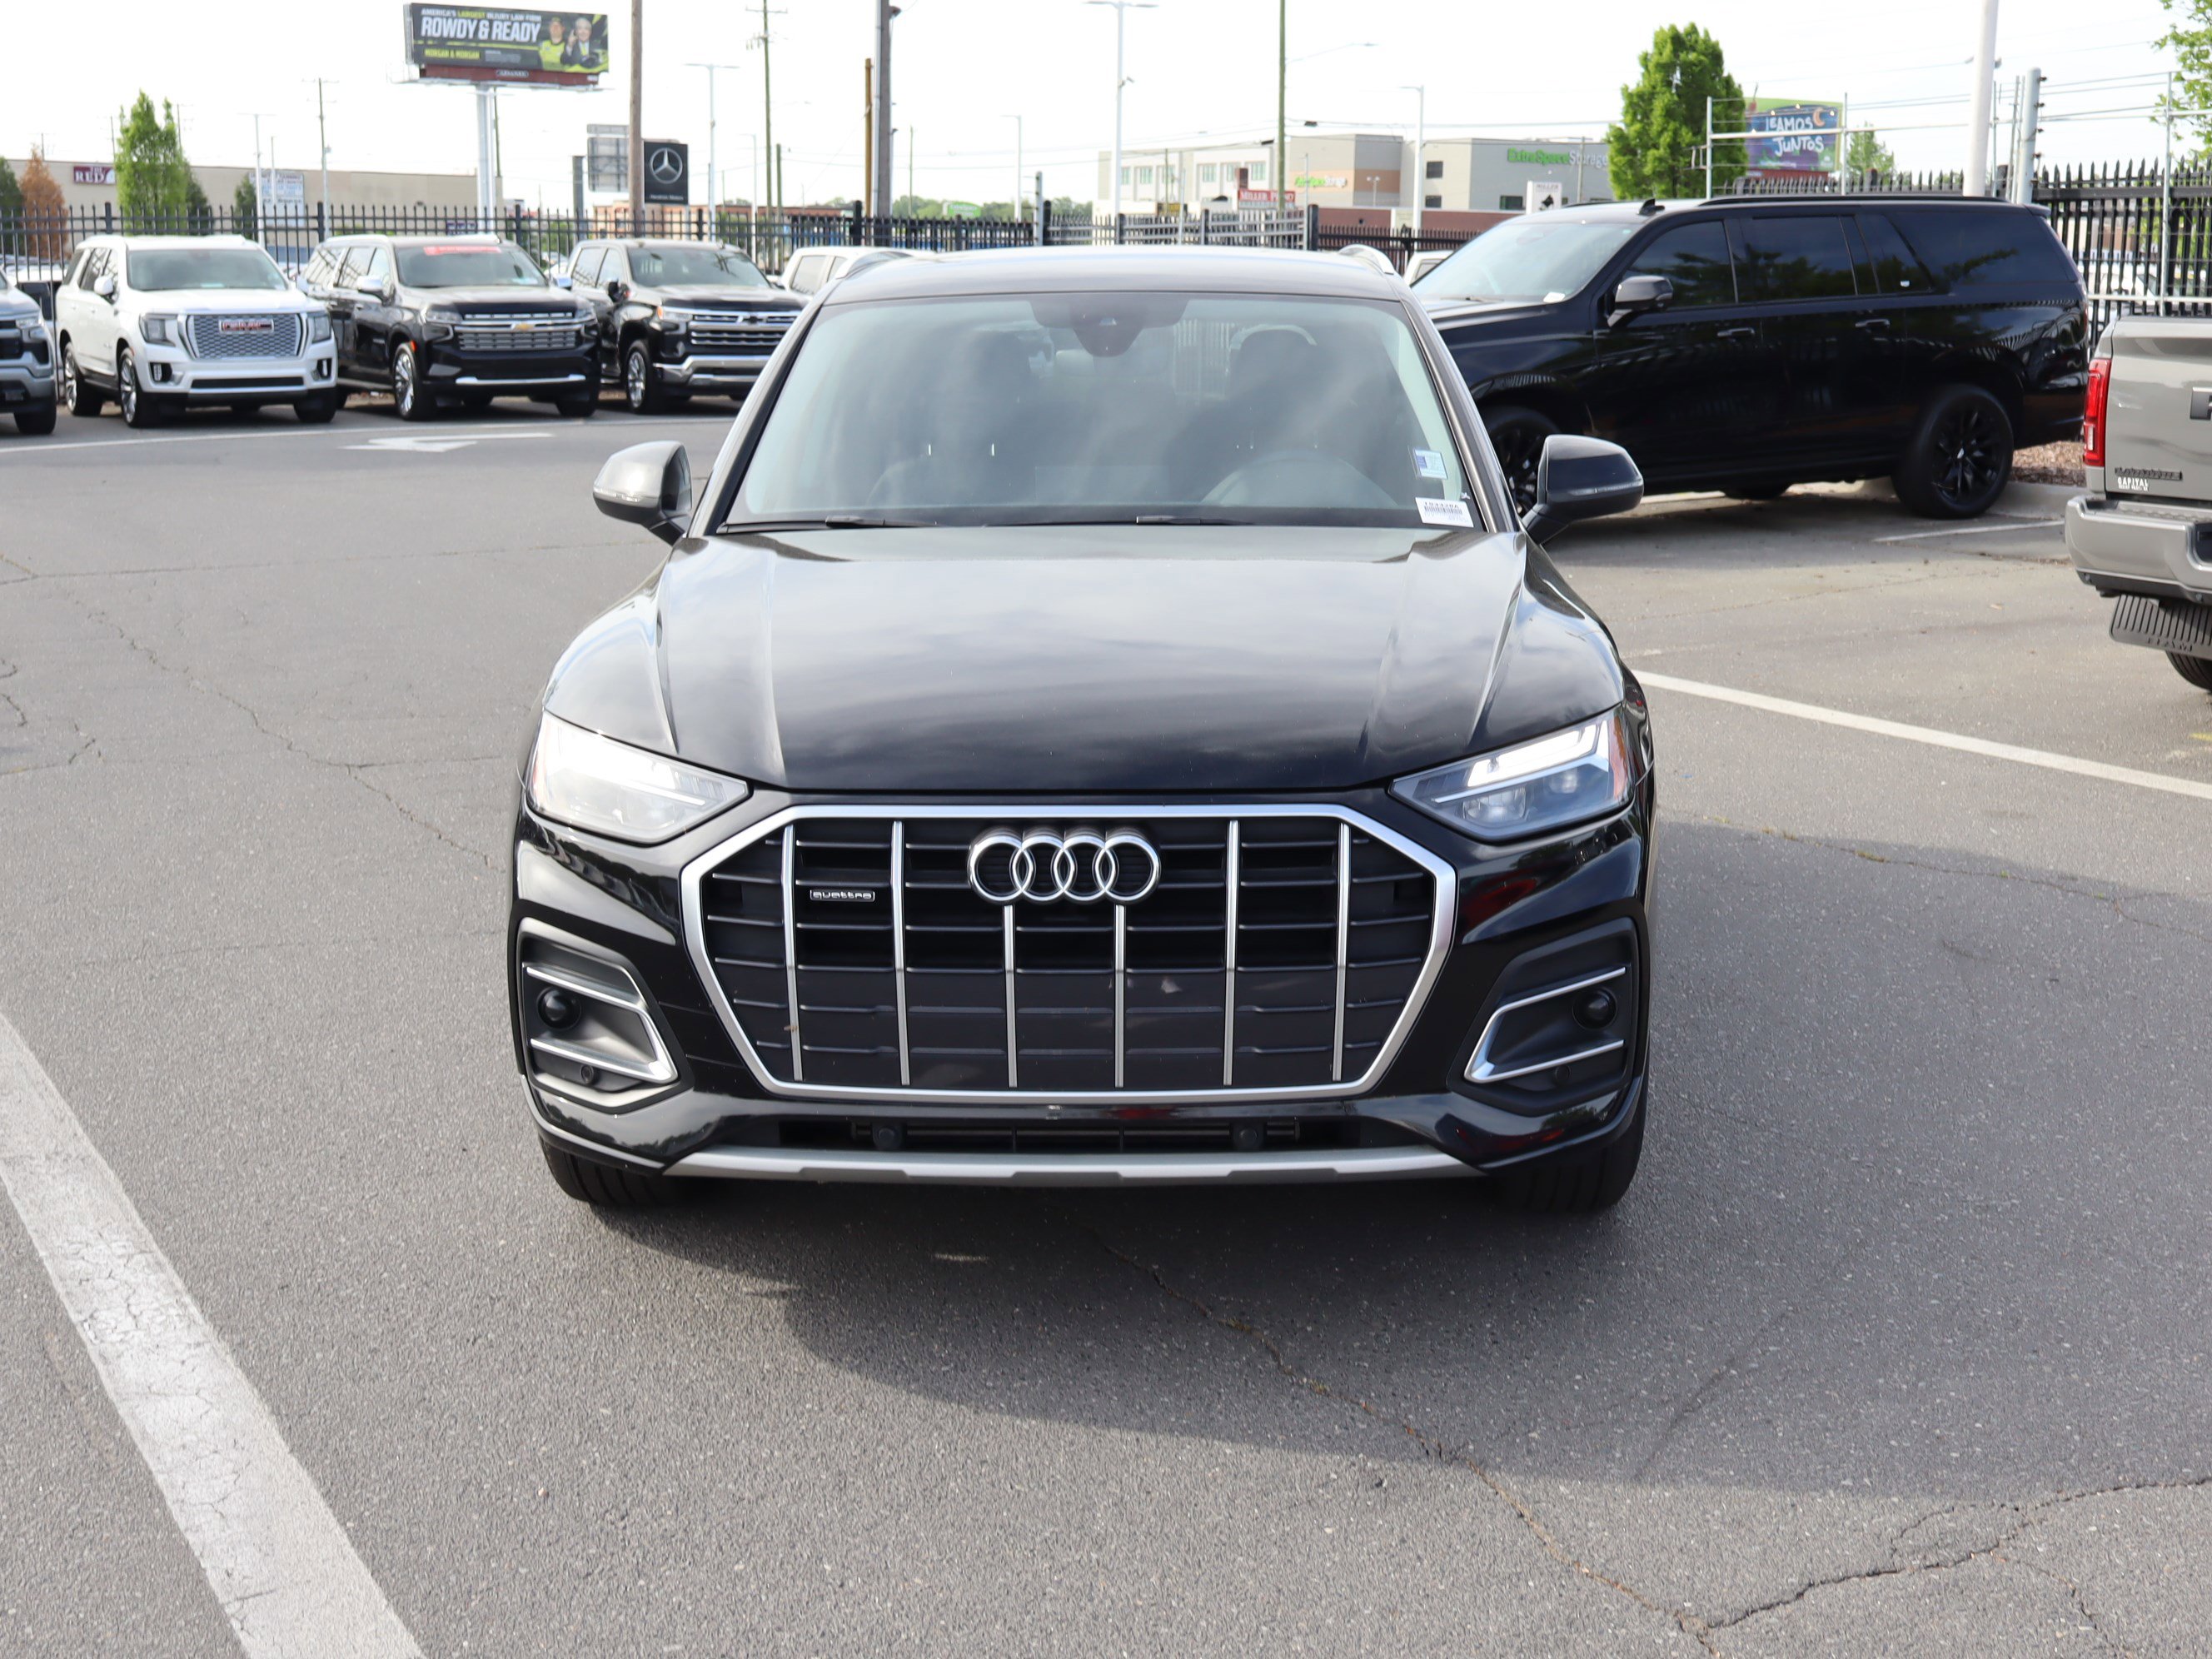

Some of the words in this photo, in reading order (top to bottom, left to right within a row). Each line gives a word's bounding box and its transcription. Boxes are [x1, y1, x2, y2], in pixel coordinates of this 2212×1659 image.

[421, 7, 456, 17] AMERICA'S
[457, 9, 486, 18] LARGEST
[486, 11, 510, 20] INJURY
[511, 12, 525, 21] LAW
[421, 17, 477, 39] ROWDY
[478, 19, 490, 40] &
[491, 21, 541, 42] READY
[424, 48, 450, 57] MORGAN
[455, 50, 481, 59] MORGAN
[1270, 192, 1295, 202] PNO
[813, 891, 872, 899] quattro
